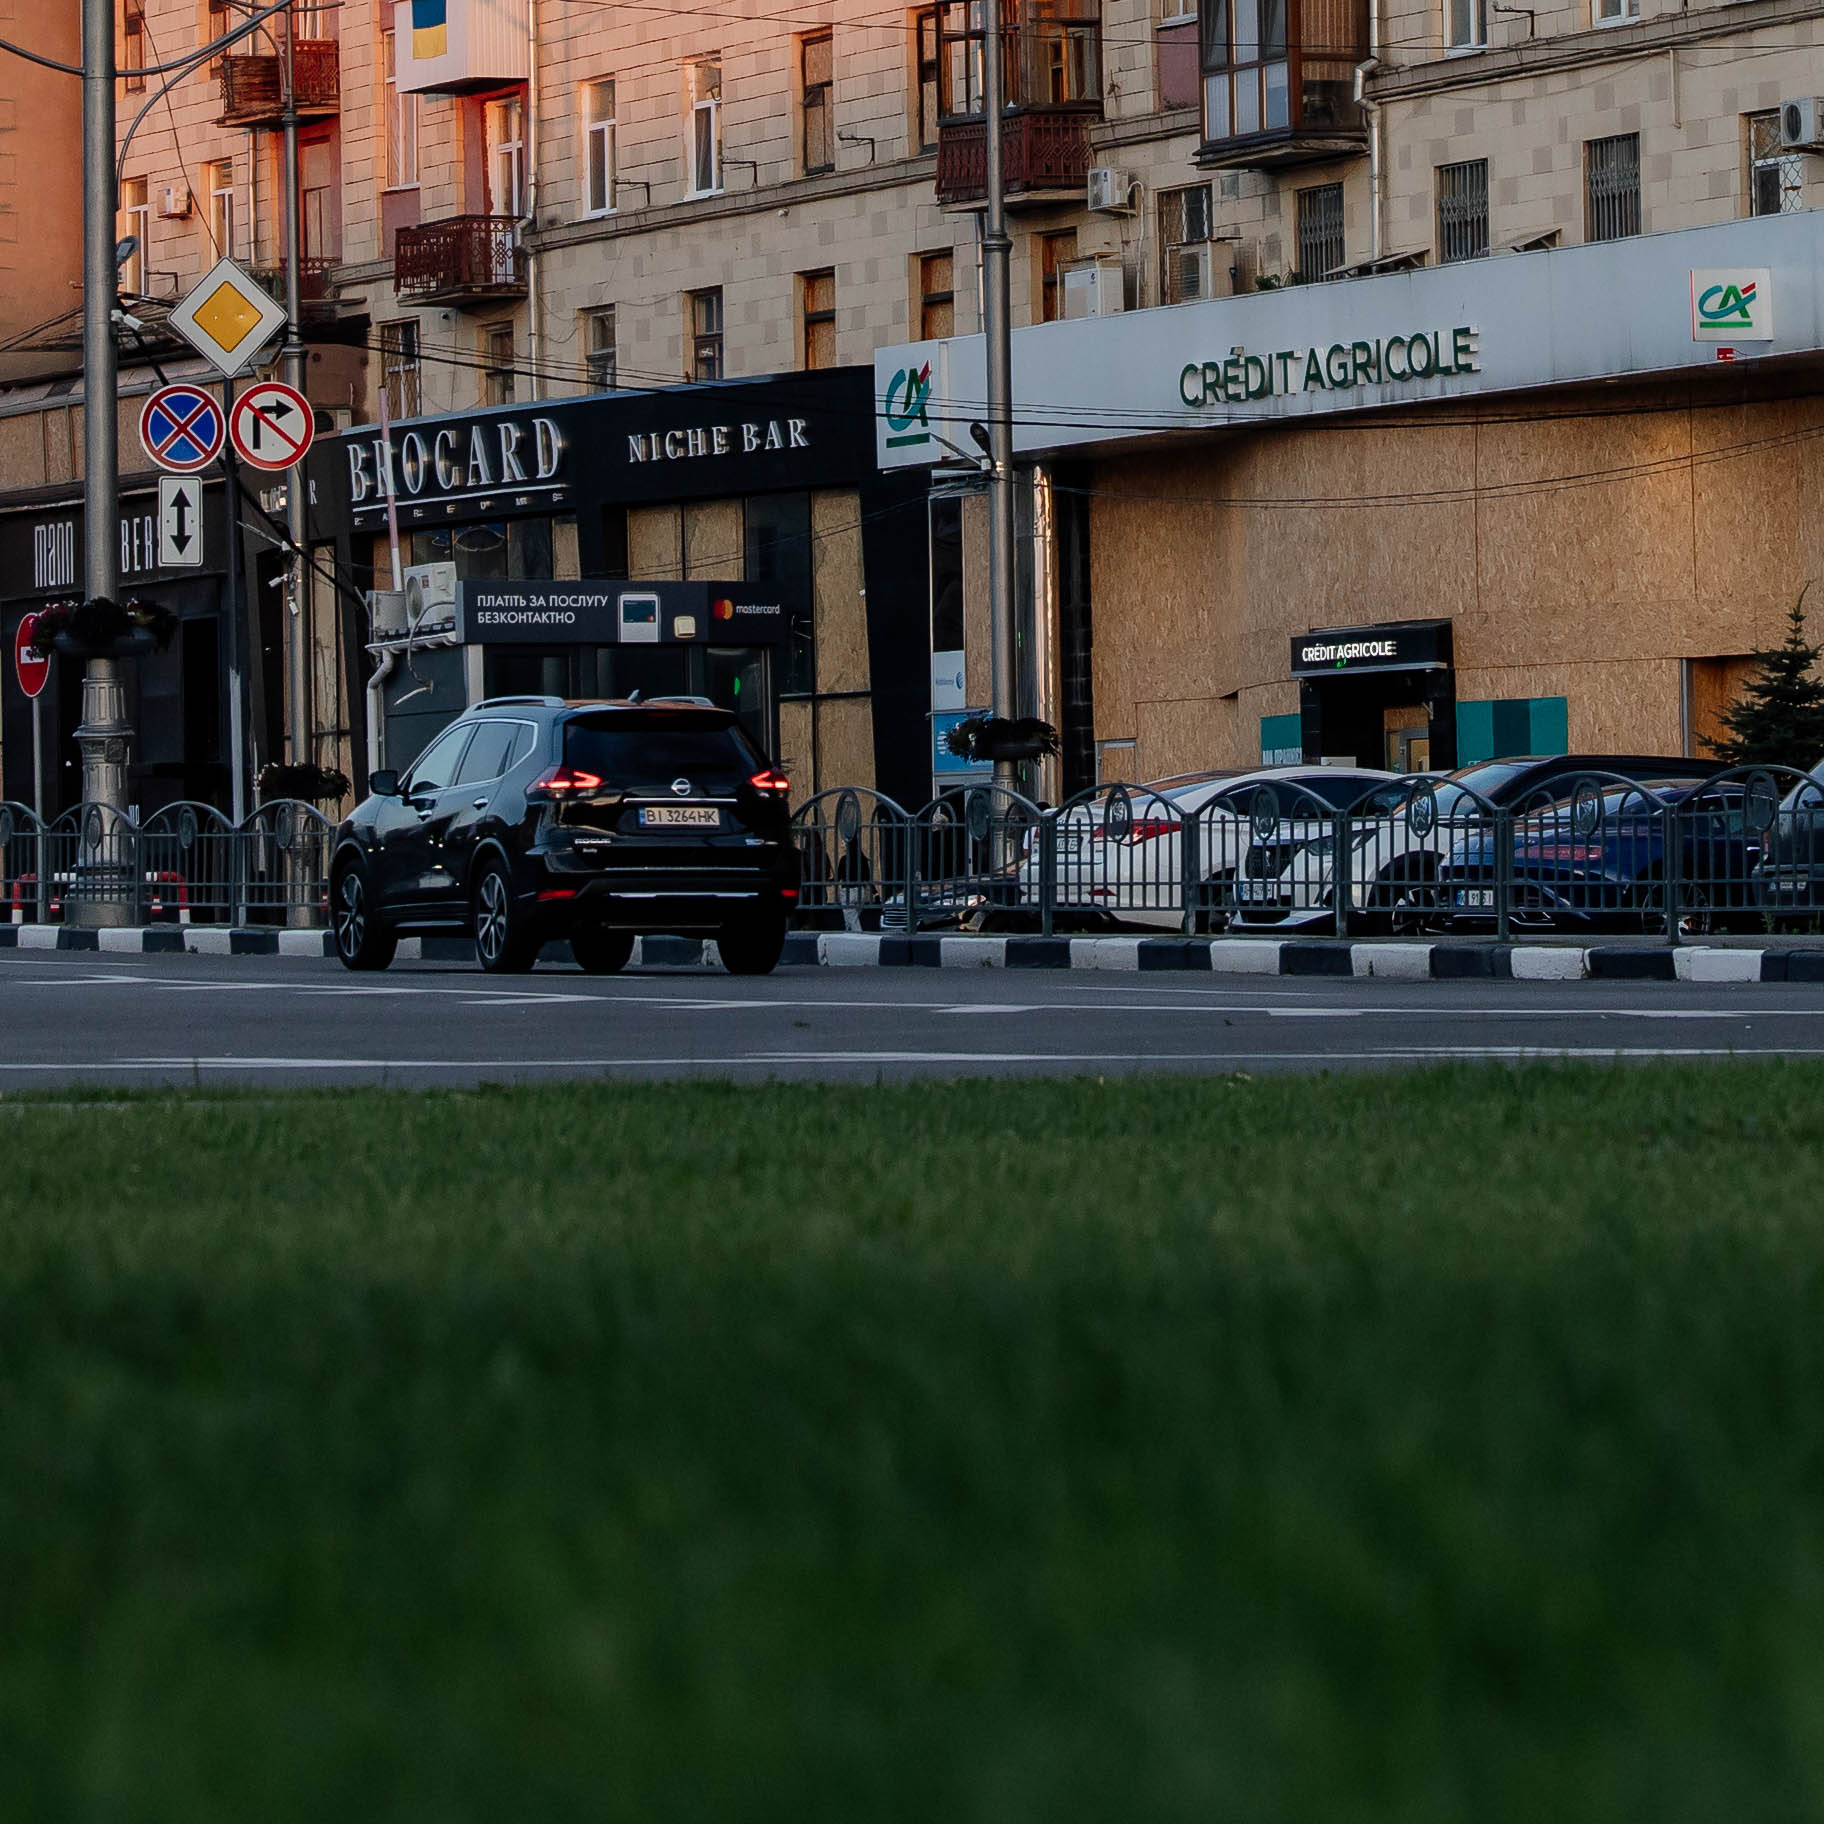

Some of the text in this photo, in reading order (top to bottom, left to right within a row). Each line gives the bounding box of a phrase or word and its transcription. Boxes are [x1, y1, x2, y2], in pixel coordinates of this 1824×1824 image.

[1180, 327, 1478, 407] CRÉDIT AGRICOLE
[628, 419, 810, 463] NICHE BAR
[347, 418, 564, 502] BROCARD
[121, 516, 160, 573] BER
[477, 595, 609, 607] ПЛАТІТЬ ЗА ПОСЛУГУ
[477, 611, 576, 624] БЕЗКОНТАКТНО
[736, 604, 781, 615] mastercard
[1302, 640, 1395, 662] CRÉDIT AGRICOLE
